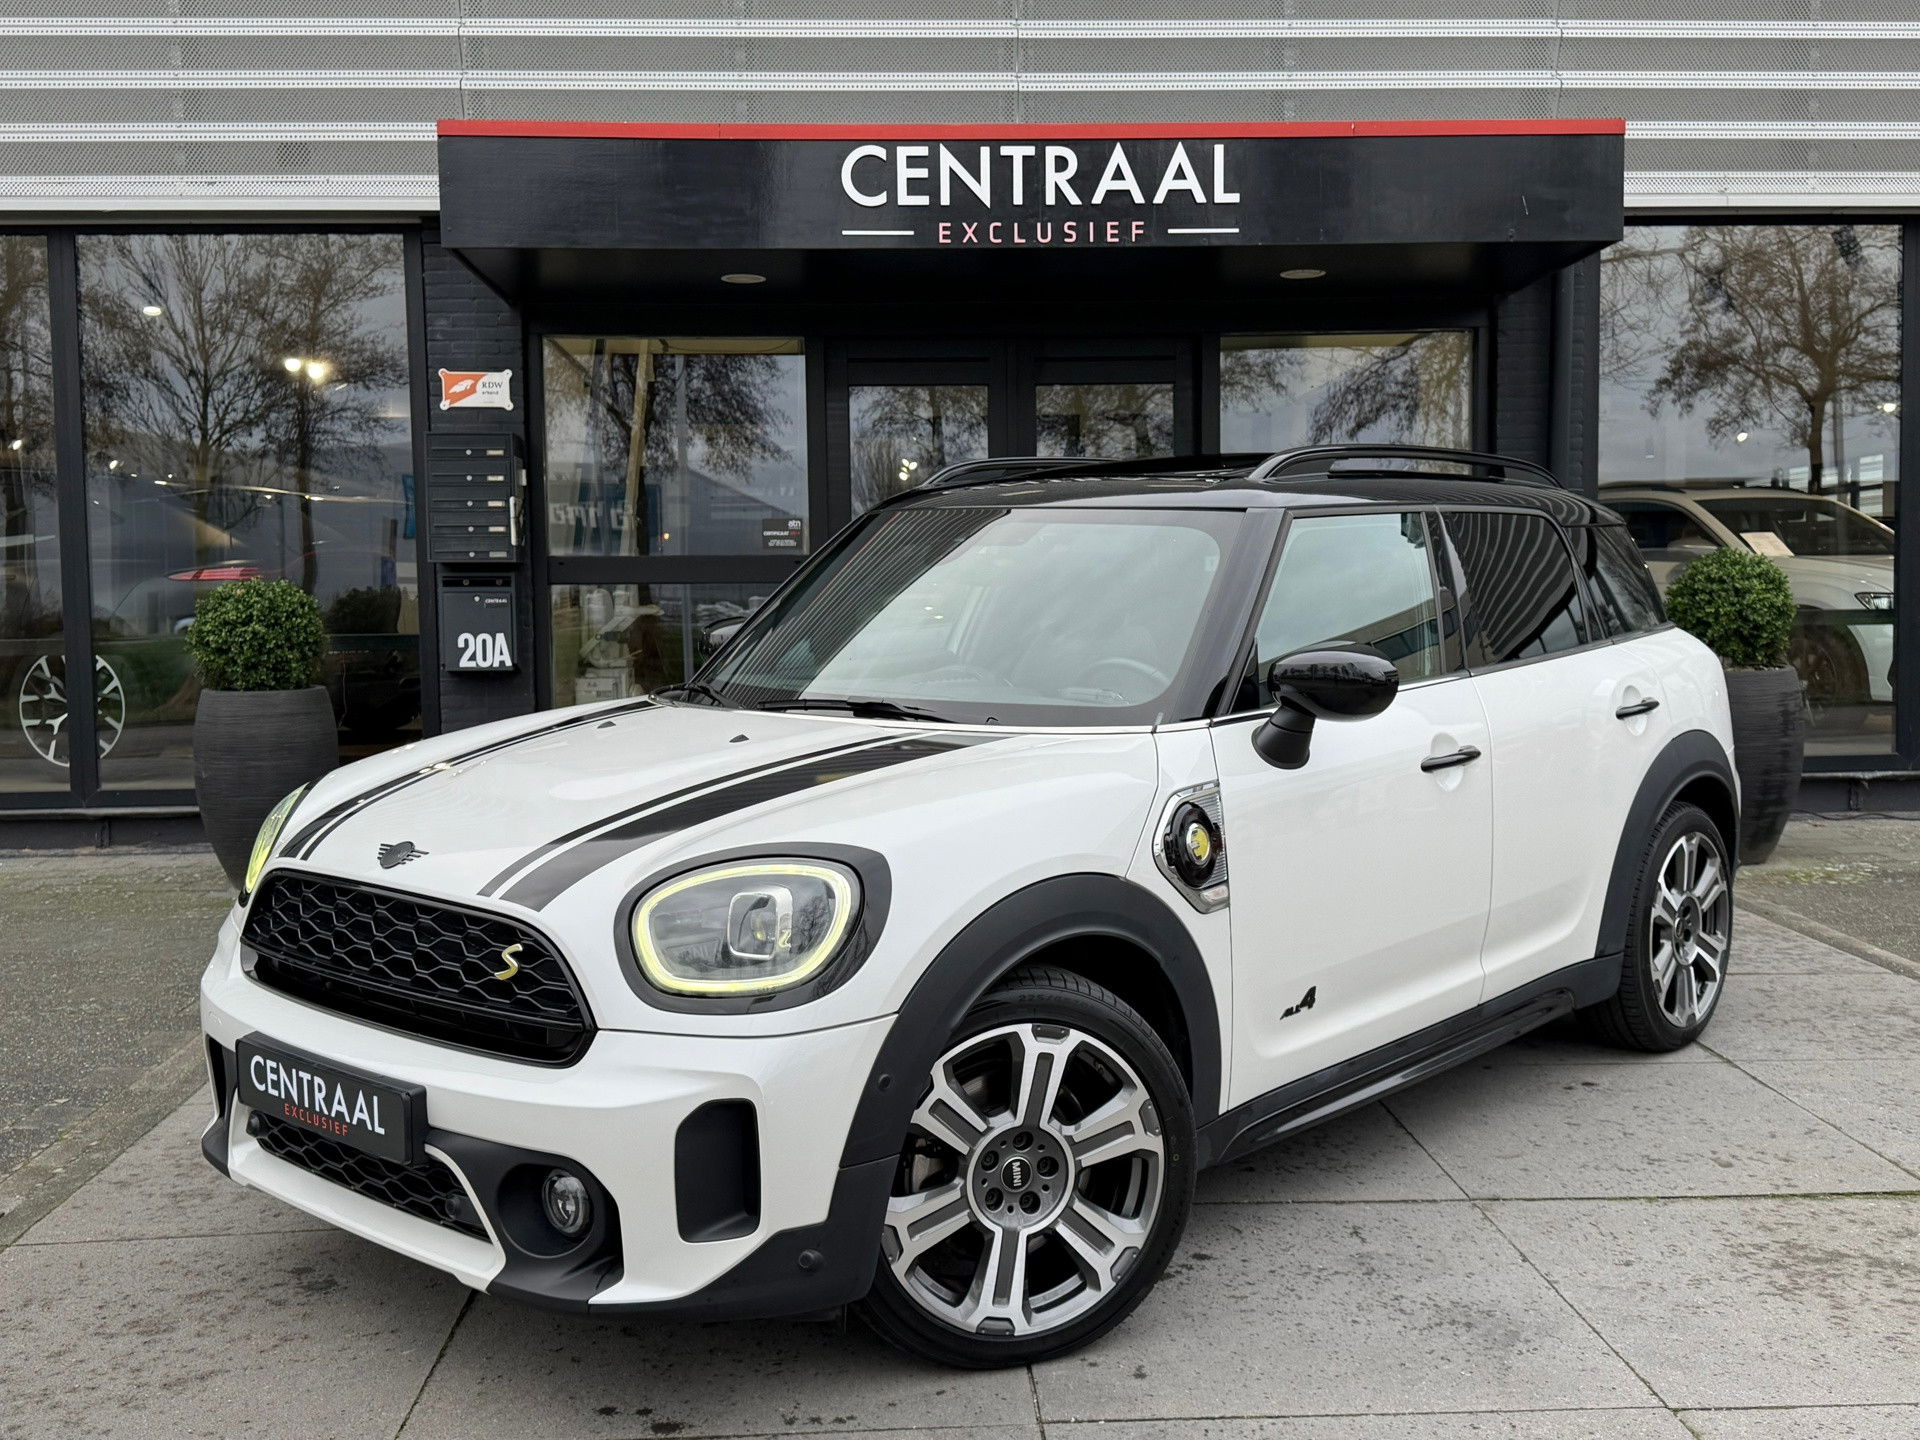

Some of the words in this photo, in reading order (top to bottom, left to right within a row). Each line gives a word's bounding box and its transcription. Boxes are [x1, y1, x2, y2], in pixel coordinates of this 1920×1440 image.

[841, 142, 1240, 208] CENTRAAL
[939, 221, 1145, 243] EXCLUSIEF
[481, 381, 503, 389] RDW
[457, 632, 512, 667] 20A
[494, 943, 523, 980] S
[250, 1055, 385, 1135] CENTRAAL
[284, 1103, 348, 1136] EXCLUSIEF
[1012, 1161, 1021, 1187] MINI
